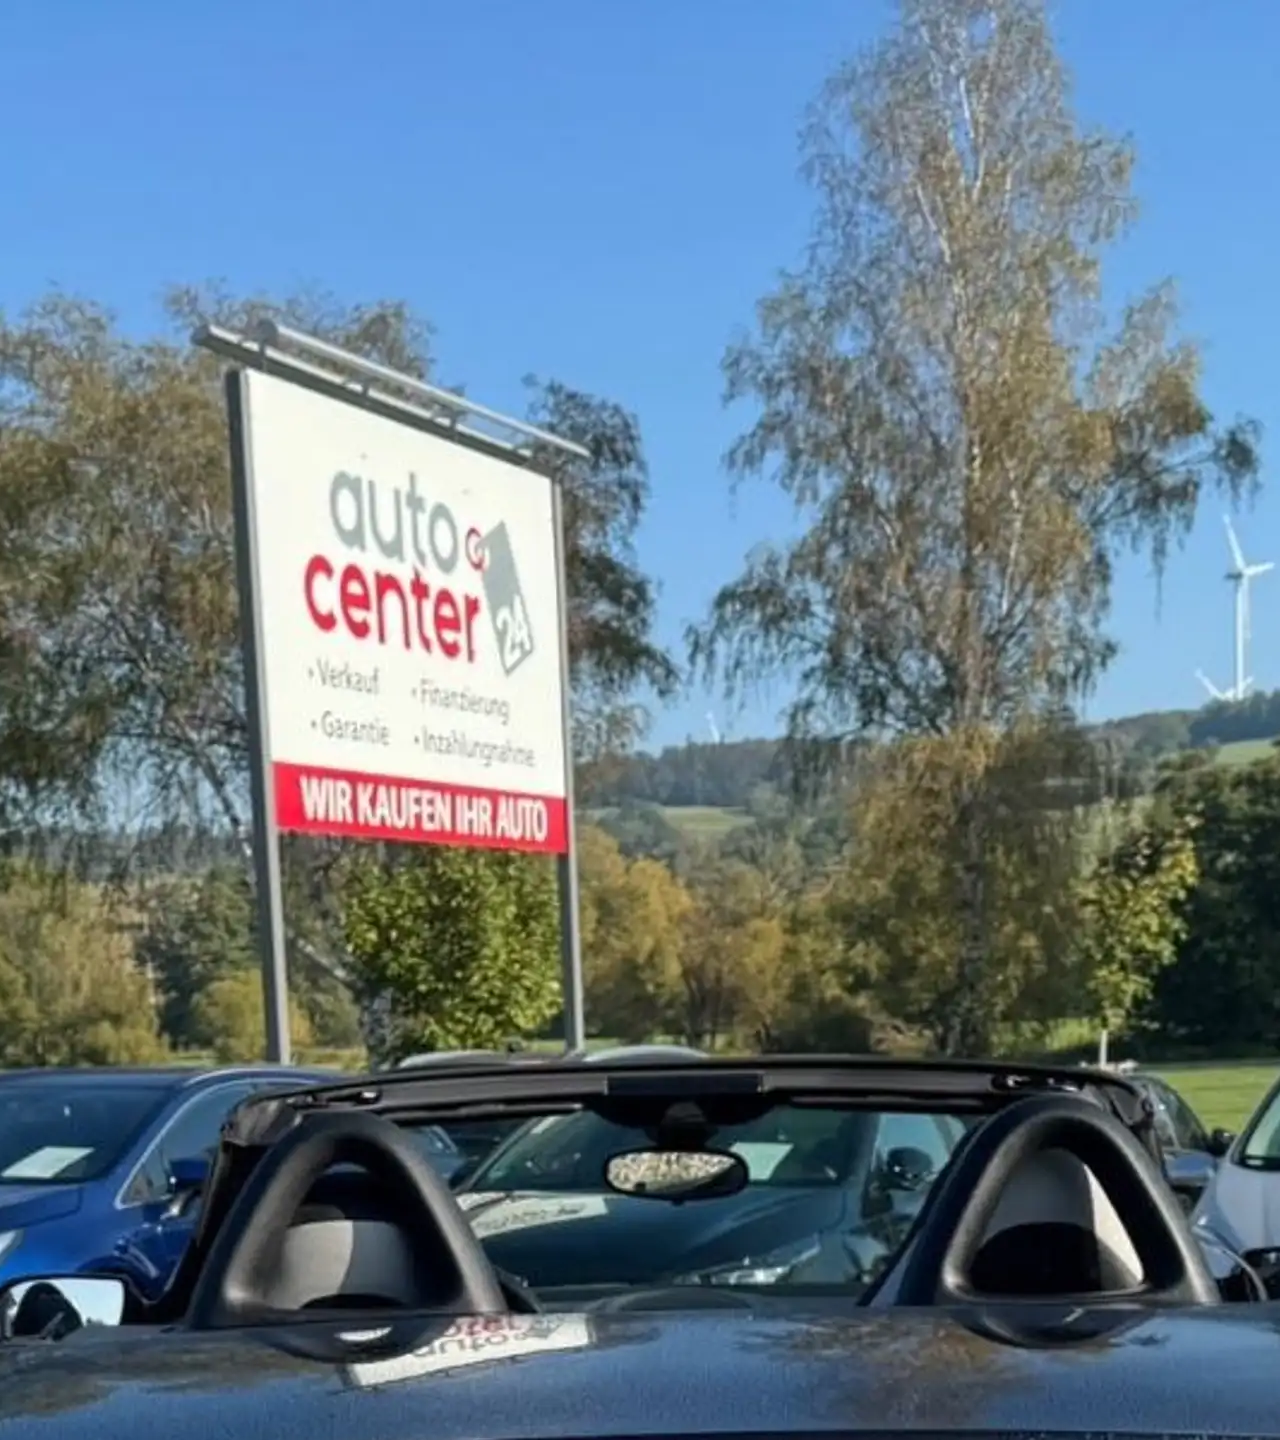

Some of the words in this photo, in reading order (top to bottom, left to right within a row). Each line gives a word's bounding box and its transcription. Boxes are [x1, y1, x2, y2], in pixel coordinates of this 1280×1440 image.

[329, 470, 459, 575] auto
[304, 554, 480, 663] center
[317, 657, 380, 696] Verkauf
[420, 677, 509, 726] Finanzierung
[321, 709, 390, 747] Garantie
[300, 774, 353, 824] WIR
[356, 781, 451, 833] KAUFEN
[455, 795, 493, 837] IHR
[496, 797, 548, 842] AUTO
